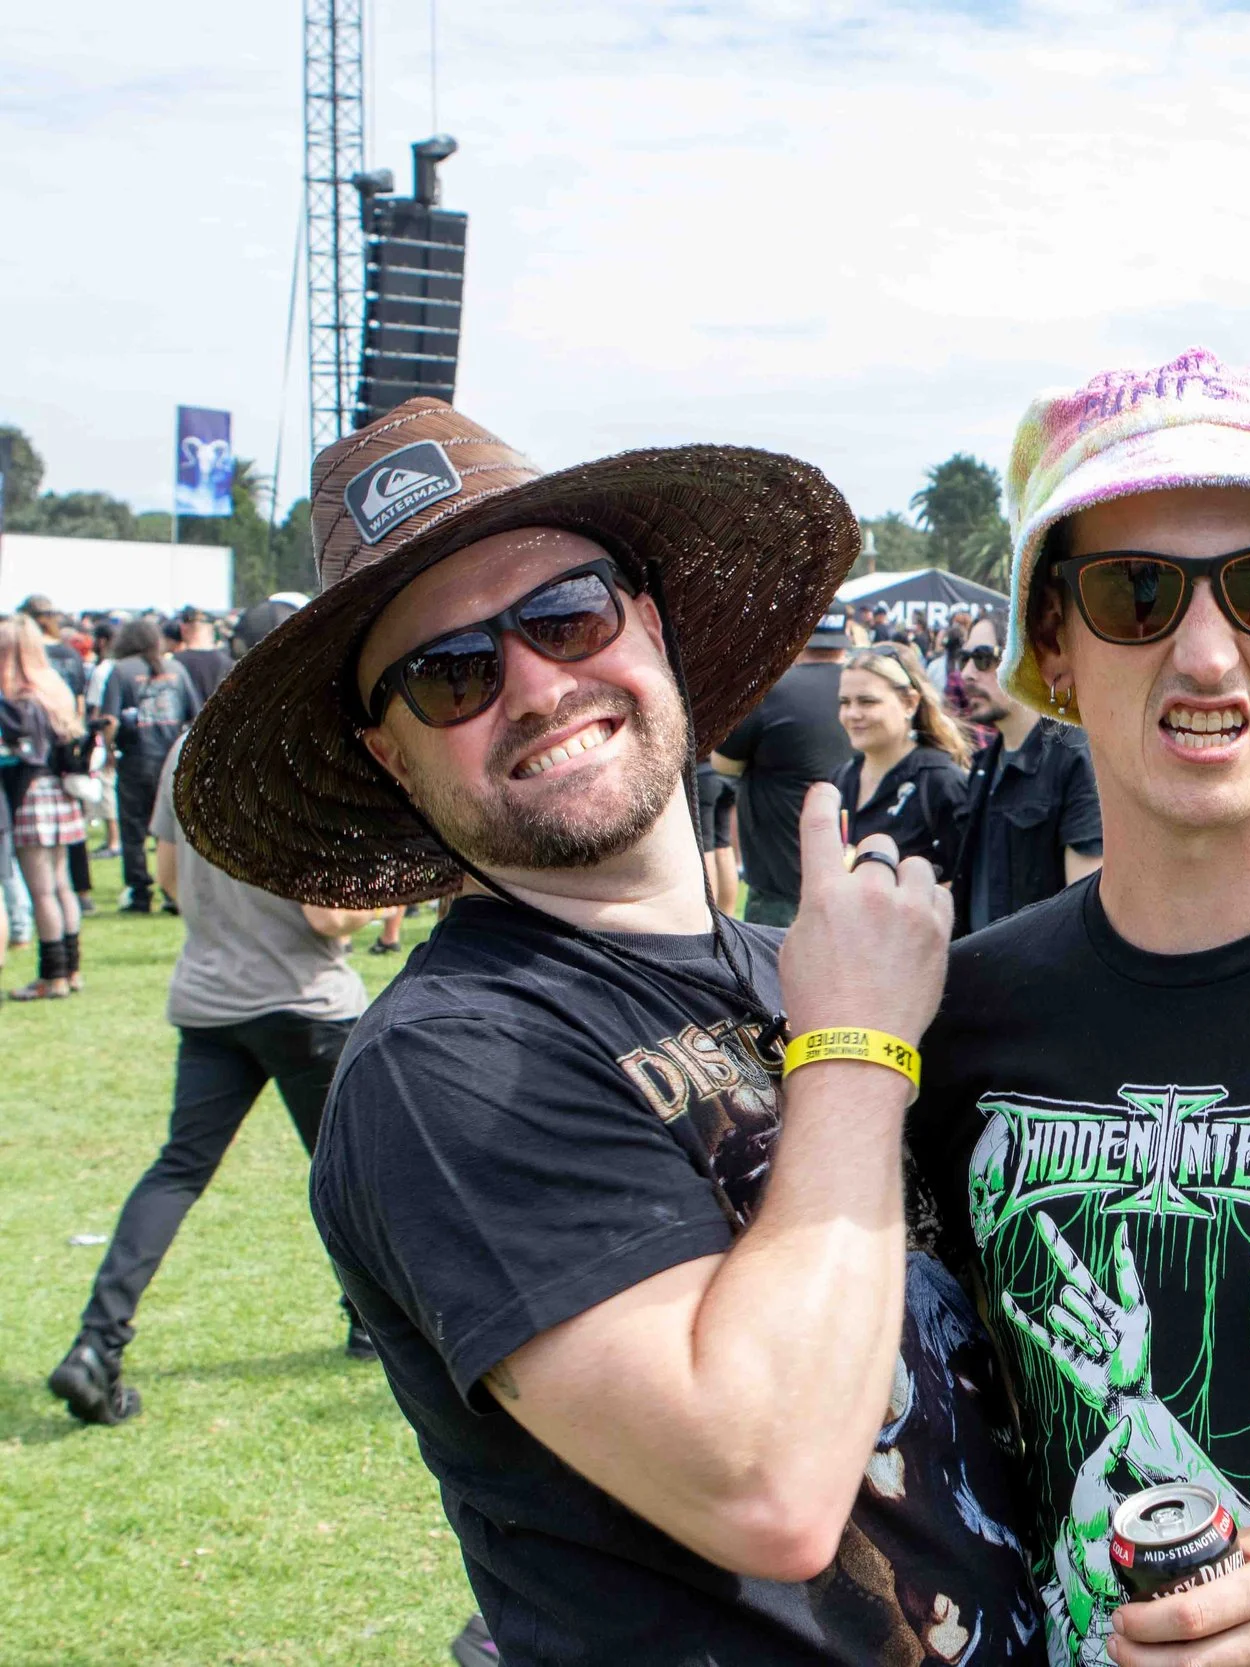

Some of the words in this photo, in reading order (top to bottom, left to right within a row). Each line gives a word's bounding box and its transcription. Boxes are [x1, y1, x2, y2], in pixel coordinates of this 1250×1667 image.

[369, 479, 451, 532] WATERMAN
[807, 1031, 869, 1049] VERIFIED
[883, 1042, 913, 1071] 18+
[1024, 1120, 1152, 1185] HIDDEN
[1112, 1541, 1129, 1562] COLA
